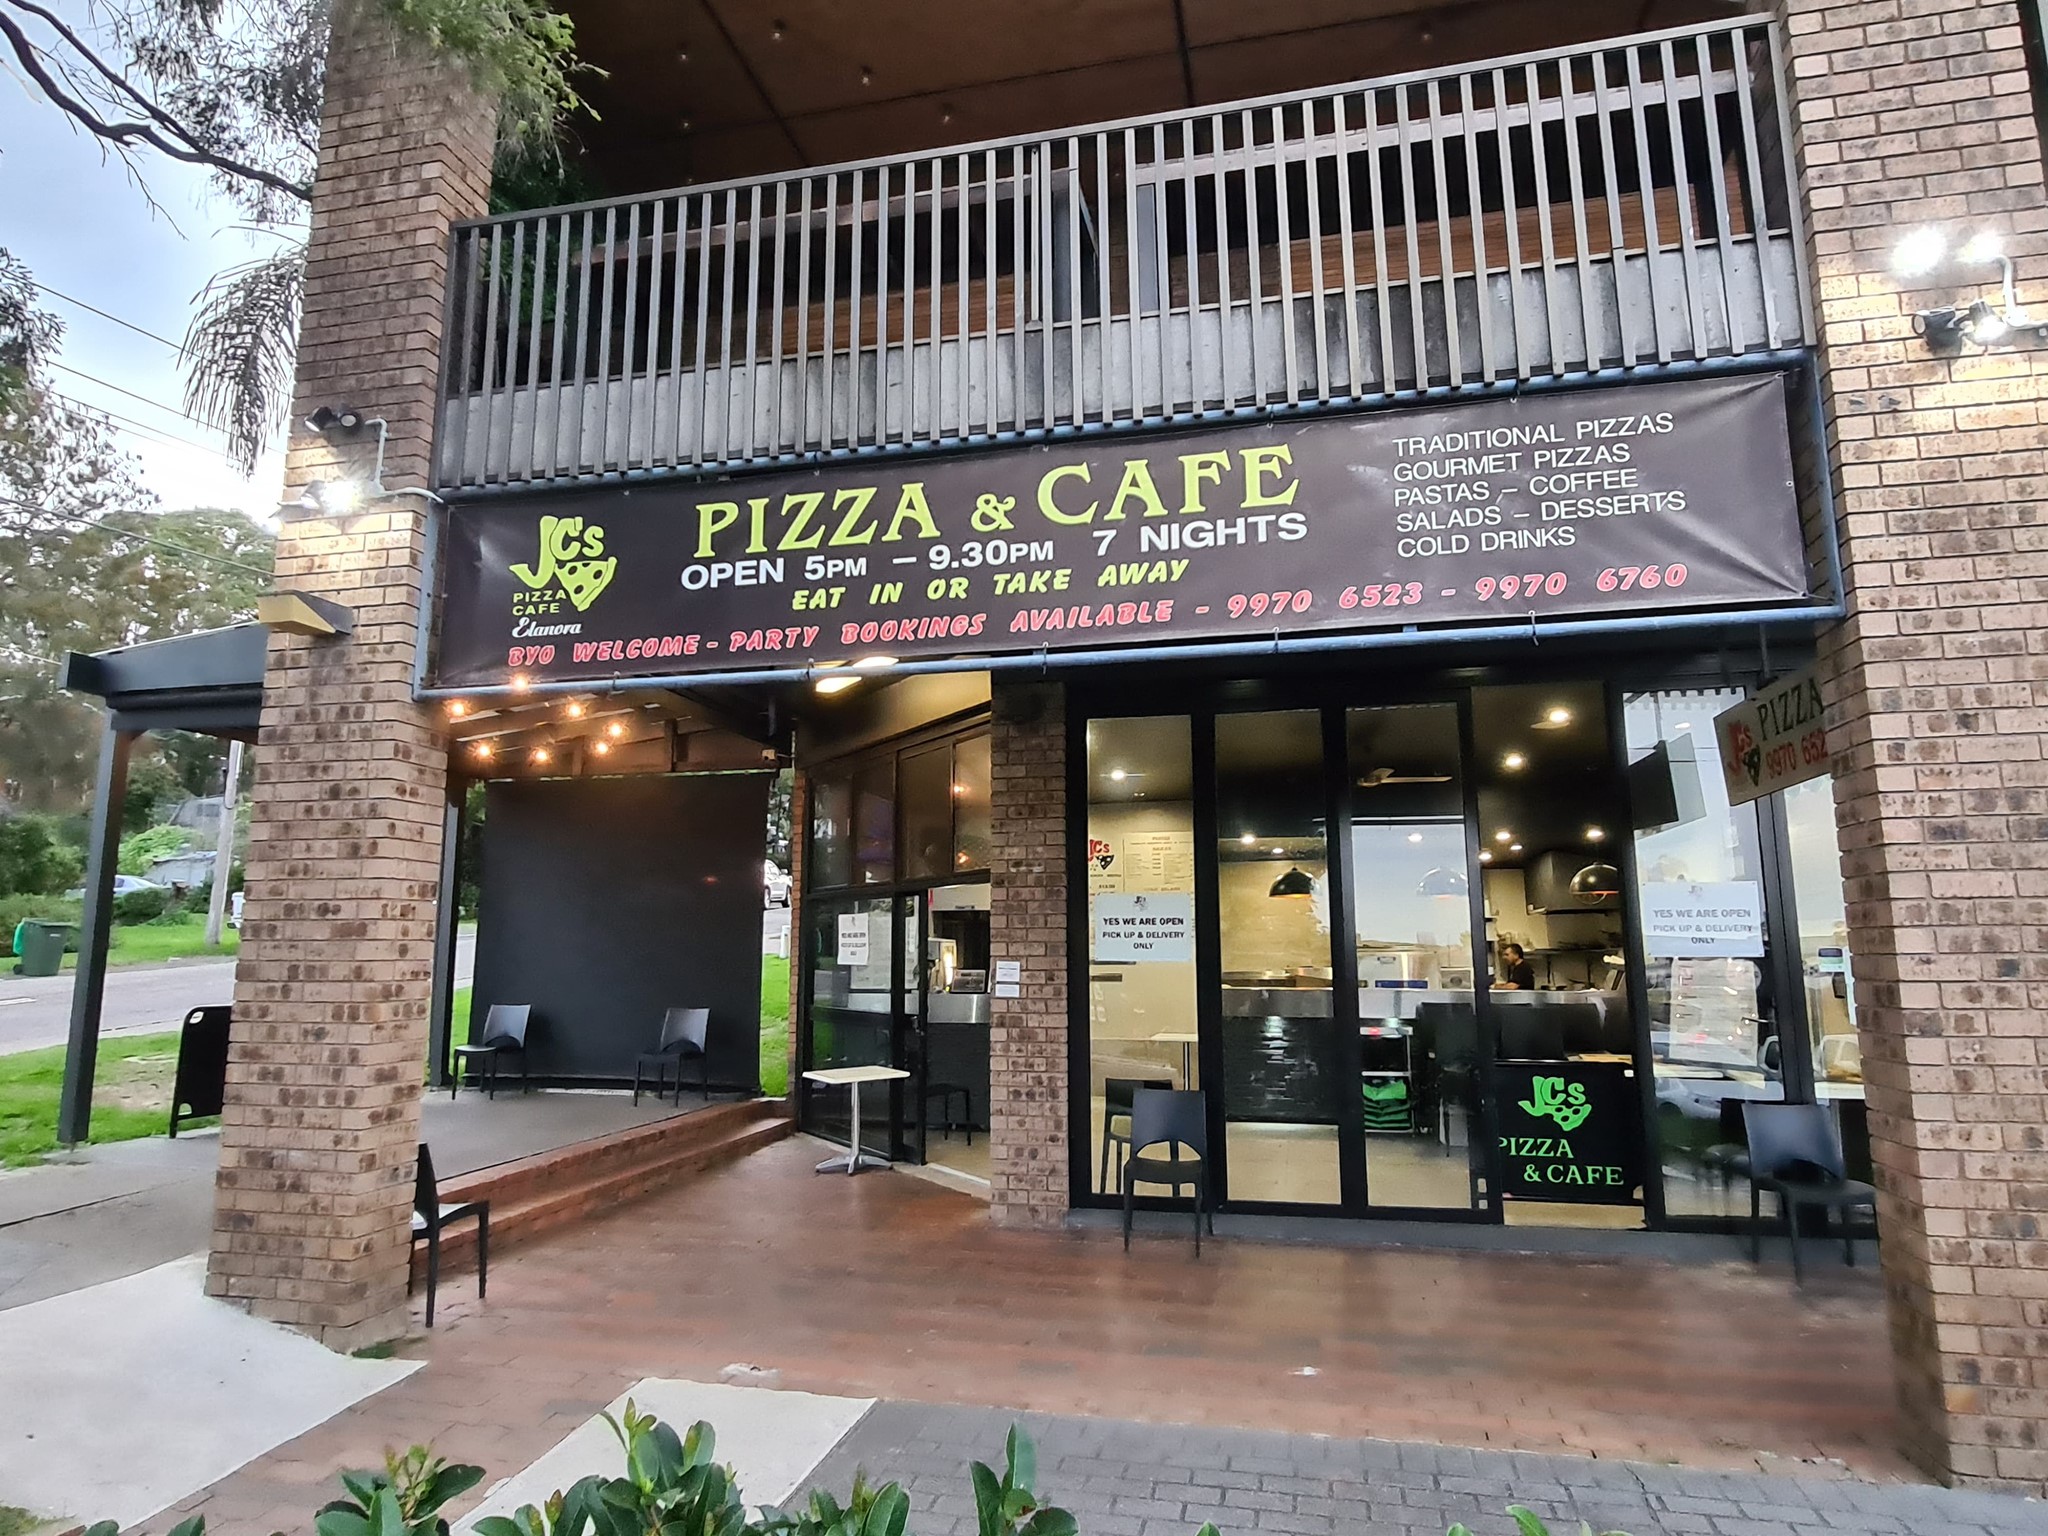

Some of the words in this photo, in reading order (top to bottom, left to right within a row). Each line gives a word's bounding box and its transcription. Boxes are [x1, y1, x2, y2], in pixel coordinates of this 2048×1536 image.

[1392, 424, 1565, 457] TRADITIONAL
[1576, 412, 1674, 440] PIZZAS
[1393, 452, 1522, 483] GOURMET
[1534, 443, 1630, 470] PIZZAS
[694, 482, 941, 559] PIZZA
[970, 493, 1016, 532] &
[1037, 443, 1300, 526] CAFE
[1394, 481, 1490, 507] PASTAS
[1529, 468, 1638, 497] COFFEE
[1396, 504, 1501, 533] SALADS
[1541, 490, 1686, 521] DESSERTS
[509, 515, 604, 589] JC's
[681, 558, 784, 591] OPEN
[804, 555, 867, 580] 5PM
[928, 539, 1054, 571] 9.30PM
[1092, 529, 1117, 557] 7
[1140, 512, 1309, 553] NIGHTS
[1397, 533, 1469, 558] COLD
[1480, 526, 1575, 553] DRINKS
[513, 589, 567, 603] PIZZA
[792, 587, 846, 611] EAT
[869, 582, 903, 605] IN
[926, 577, 970, 601] OR
[994, 568, 1072, 596] TAKE
[1098, 558, 1189, 588] AWAY
[508, 645, 555, 667] BYO
[573, 634, 700, 663] WELCOME
[729, 626, 819, 652] PARTY
[841, 612, 987, 644] BOOKINGS
[1010, 599, 1174, 633] AVAILABLE
[1227, 590, 1313, 618] 9970
[1338, 582, 1423, 609] 6523
[1475, 572, 1567, 601] 9970
[1596, 563, 1688, 592] 6760
[512, 603, 560, 616] CAFE
[512, 616, 582, 638] Elanora
[1757, 677, 1824, 741] PIZZA
[1766, 741, 1797, 779] 9970
[1103, 917, 1120, 926] YES
[1122, 917, 1137, 926] WE
[1139, 917, 1157, 926] ARE
[1159, 917, 1184, 926] OPEN
[1653, 909, 1673, 918] YES
[1675, 909, 1693, 918] WE
[1696, 909, 1718, 918] ARE
[1721, 909, 1751, 918] OPEN
[1653, 924, 1676, 932] PICK
[1679, 924, 1692, 932] UP
[1695, 924, 1702, 932] &
[1705, 924, 1753, 932] DELIVERY
[1102, 931, 1121, 939] PICK
[1124, 931, 1135, 939] UP
[1137, 931, 1144, 939] &
[1146, 931, 1185, 939] DELIVERY
[1133, 942, 1154, 950] ONLY
[1523, 1163, 1542, 1182] &
[1547, 1164, 1624, 1185] CAFE
